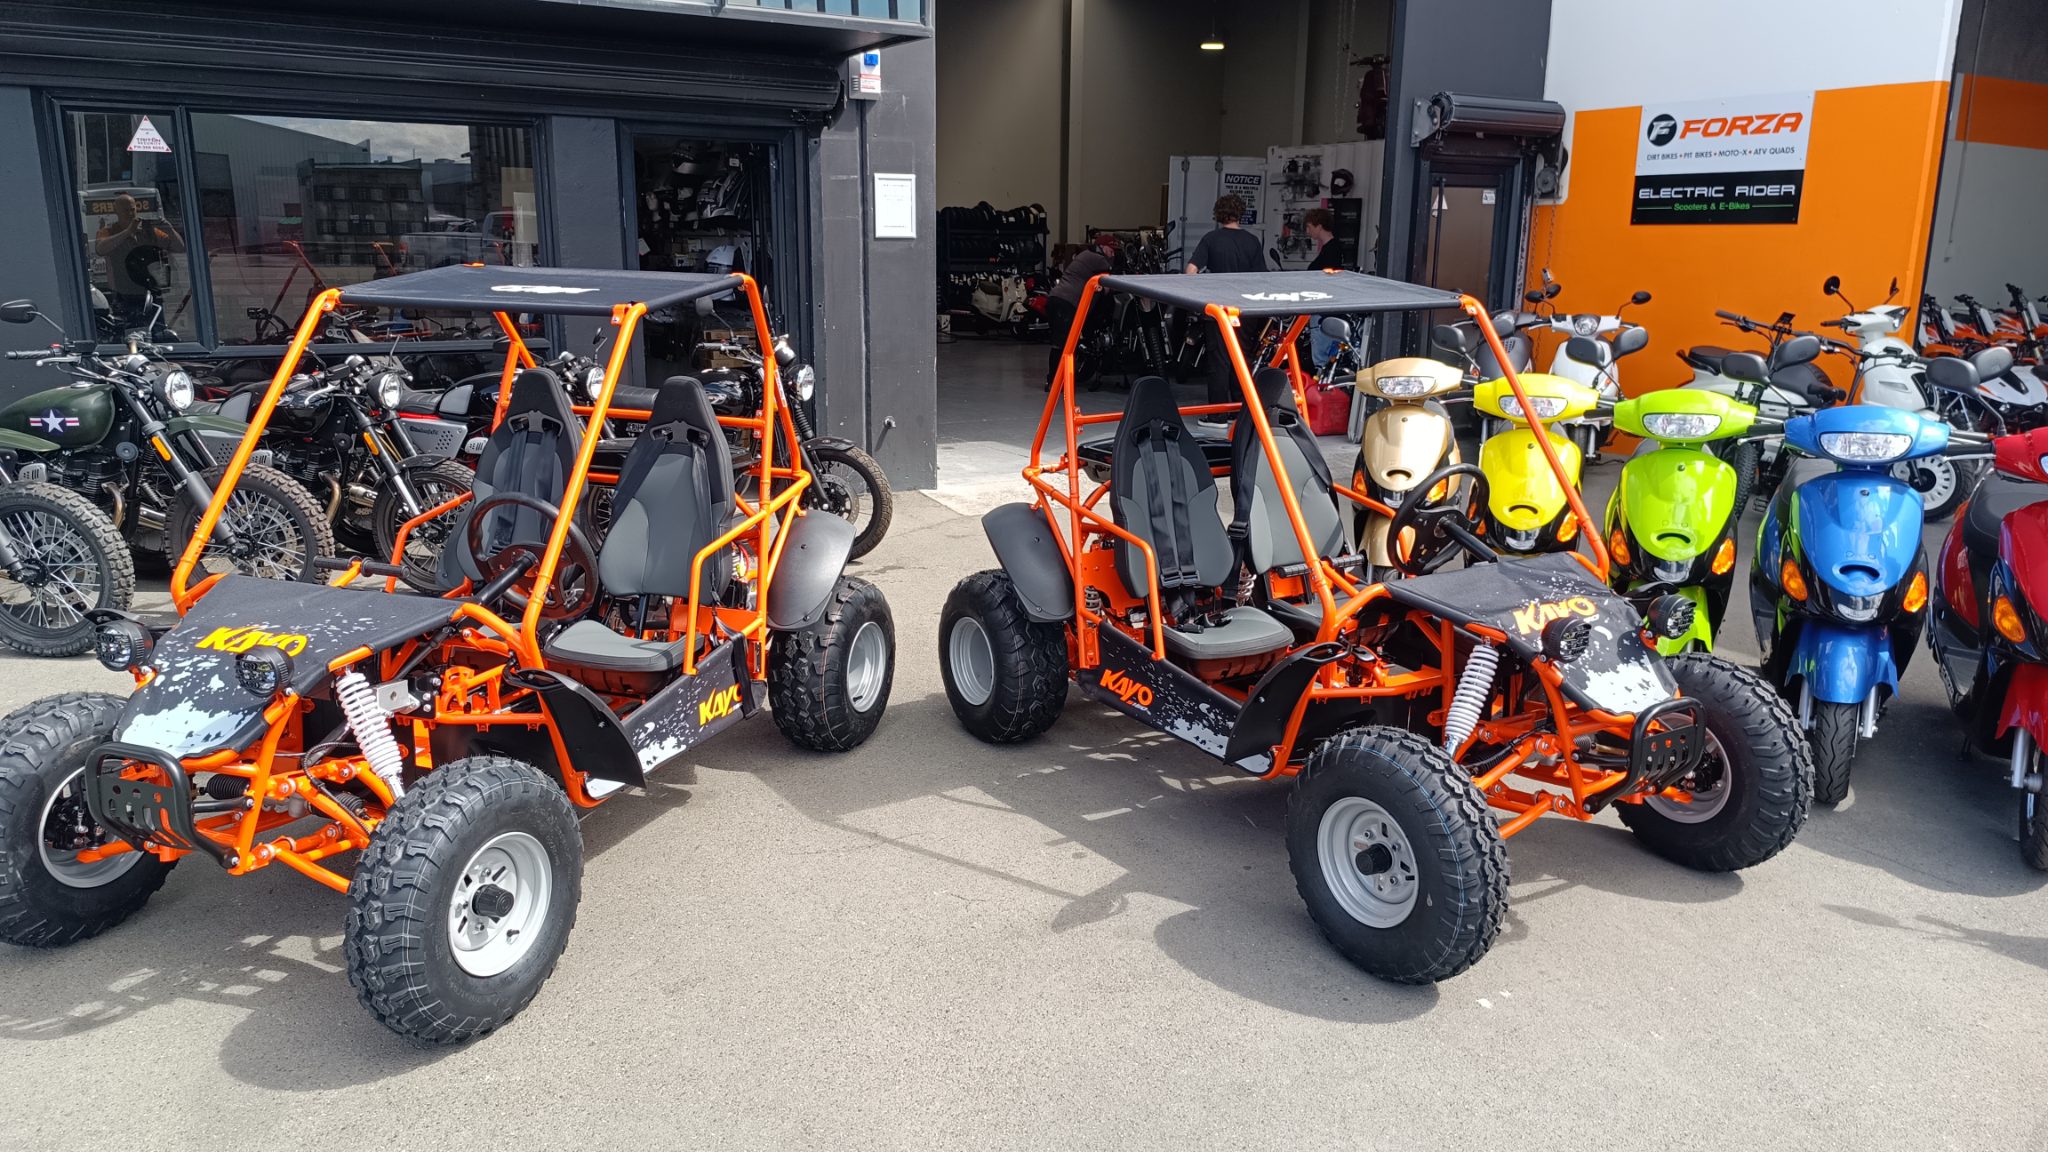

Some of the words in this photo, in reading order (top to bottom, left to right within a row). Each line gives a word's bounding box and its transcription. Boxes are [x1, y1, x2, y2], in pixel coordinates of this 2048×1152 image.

[1680, 112, 1803, 139] FORZA
[1647, 153, 1660, 161] DIRT
[1661, 152, 1678, 160] BIKES
[1684, 151, 1693, 159] PIT
[1694, 151, 1712, 159] BIKES
[1718, 149, 1748, 157] MOTO-X
[1753, 147, 1768, 156] ATV
[1769, 146, 1795, 155] QUADS
[1226, 175, 1260, 184] NOTICE
[1639, 186, 1725, 199] ELECTRIC
[1735, 184, 1796, 198] RIDER
[1673, 202, 1708, 211] Scooters
[1719, 202, 1750, 211] E-Bikes
[1100, 669, 1154, 707] KAYO
